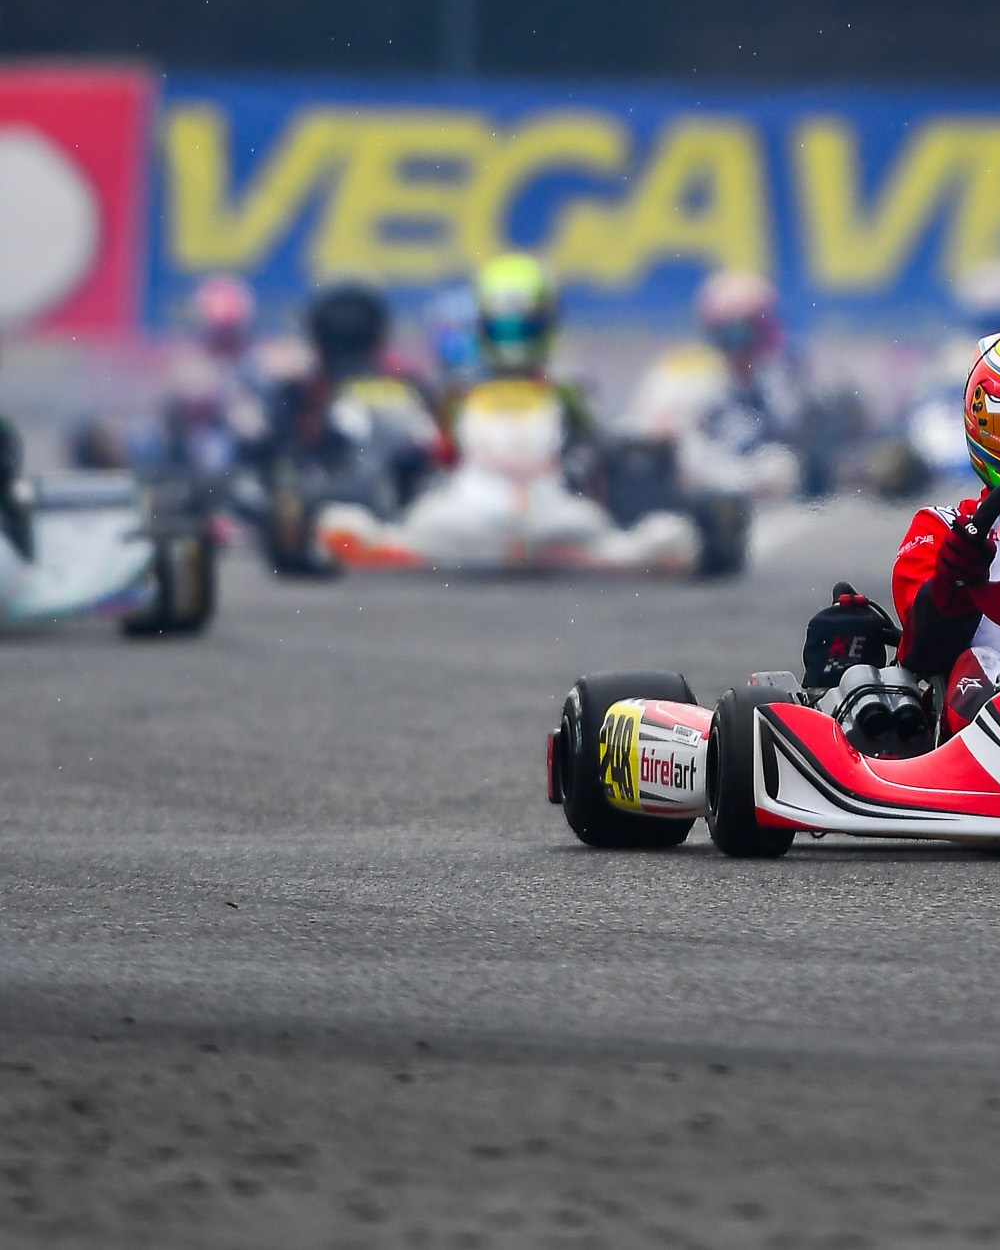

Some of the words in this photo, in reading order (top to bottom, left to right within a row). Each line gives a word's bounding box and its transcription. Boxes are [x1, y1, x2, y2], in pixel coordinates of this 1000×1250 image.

[165, 100, 775, 288] VEGA
[829, 635, 866, 659] KE
[600, 714, 634, 802] 248
[641, 747, 697, 791] birelart
